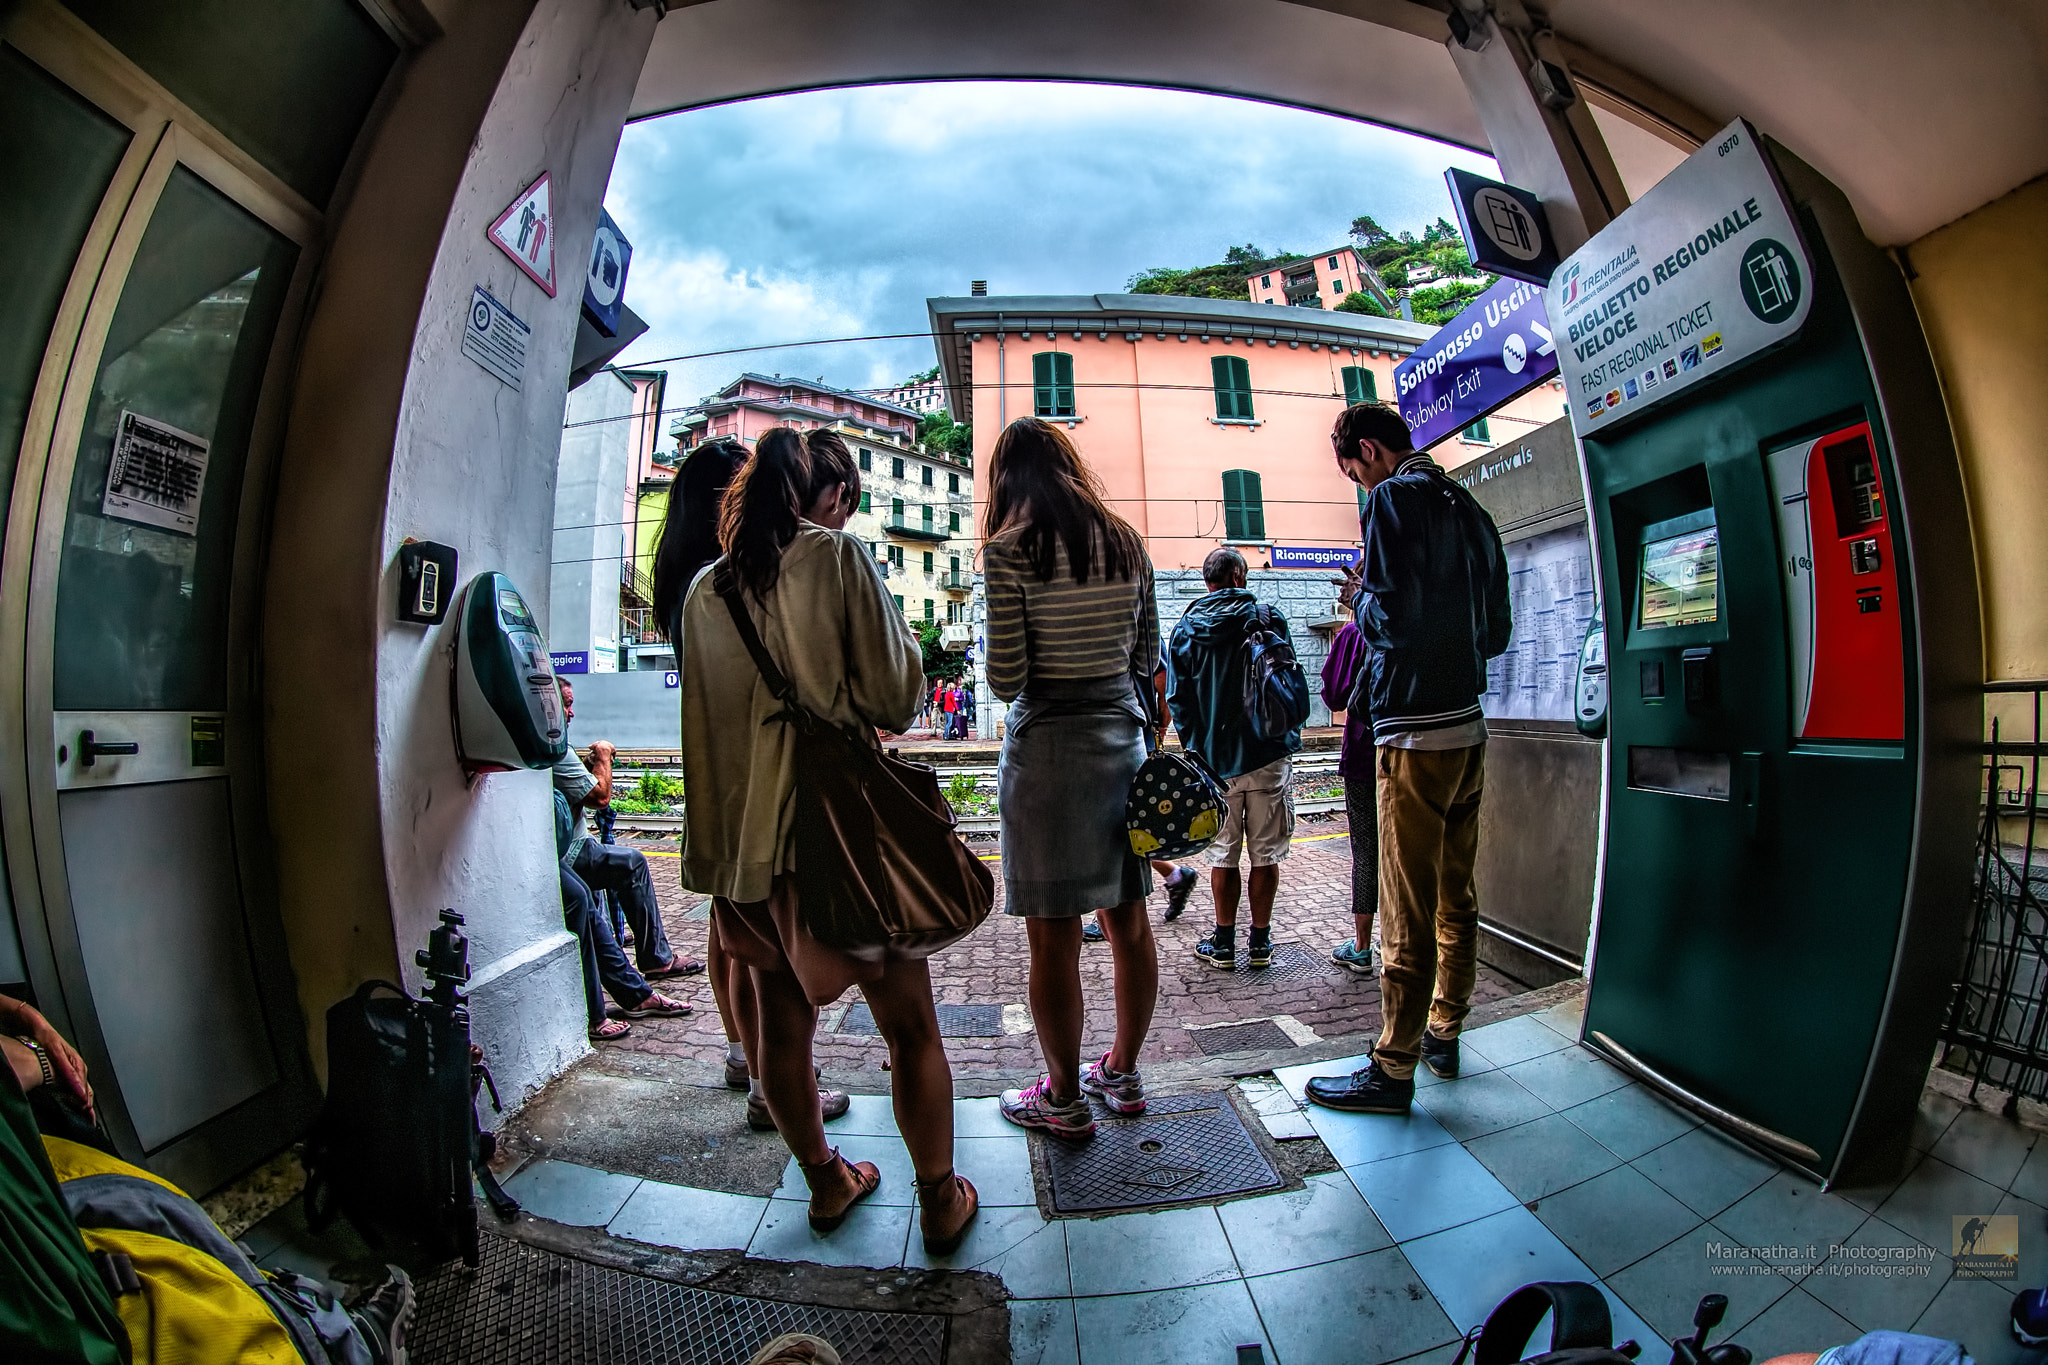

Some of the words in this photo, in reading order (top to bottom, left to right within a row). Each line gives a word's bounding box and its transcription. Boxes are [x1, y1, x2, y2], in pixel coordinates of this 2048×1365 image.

[1717, 134, 1740, 158] 0870
[1568, 276, 1650, 343] BIGLIETTO
[1652, 197, 1763, 286] REGIONALE
[1582, 245, 1637, 292] TRENITALIA
[1609, 272, 1622, 285] STATO
[1399, 321, 1483, 396] Sottopasso
[1573, 312, 1638, 363] VELOCE
[1581, 363, 1607, 394] FAST
[1608, 331, 1669, 378] REGIONAL
[1669, 301, 1714, 342] TICKET
[1405, 389, 1454, 432] Subway
[1456, 366, 1482, 399] Exit
[1589, 401, 1602, 413] VISA
[112, 456, 122, 485] AVVISO
[116, 437, 130, 486] VIAGGIATORI
[1457, 444, 1533, 489] ivi/Arrivals
[1276, 549, 1353, 563] Riomaggiore
